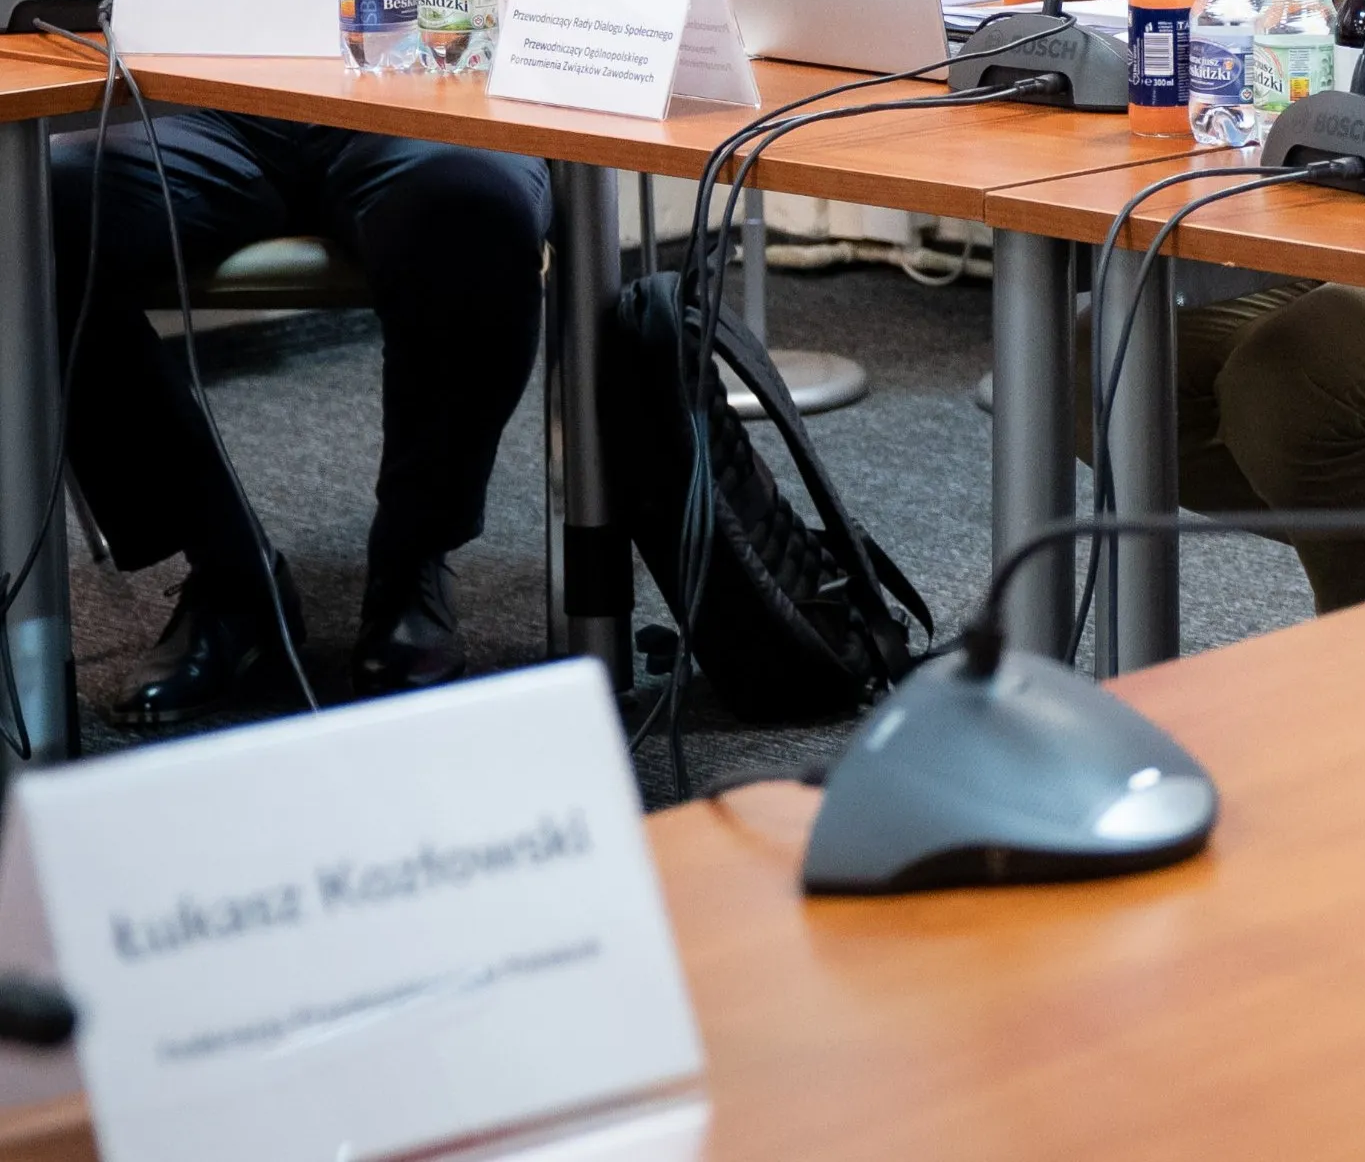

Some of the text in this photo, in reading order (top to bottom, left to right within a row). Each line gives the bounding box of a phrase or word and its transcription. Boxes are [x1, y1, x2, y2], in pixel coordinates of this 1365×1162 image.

[513, 9, 572, 30] Przewodniczący
[573, 17, 593, 32] Rady
[594, 20, 623, 36] Dialogu
[625, 24, 674, 42] Społecznego
[524, 38, 649, 66] Przewodniczący Ogólnopolskiego
[510, 54, 655, 84] Porozumienia Związków Zawodowych
